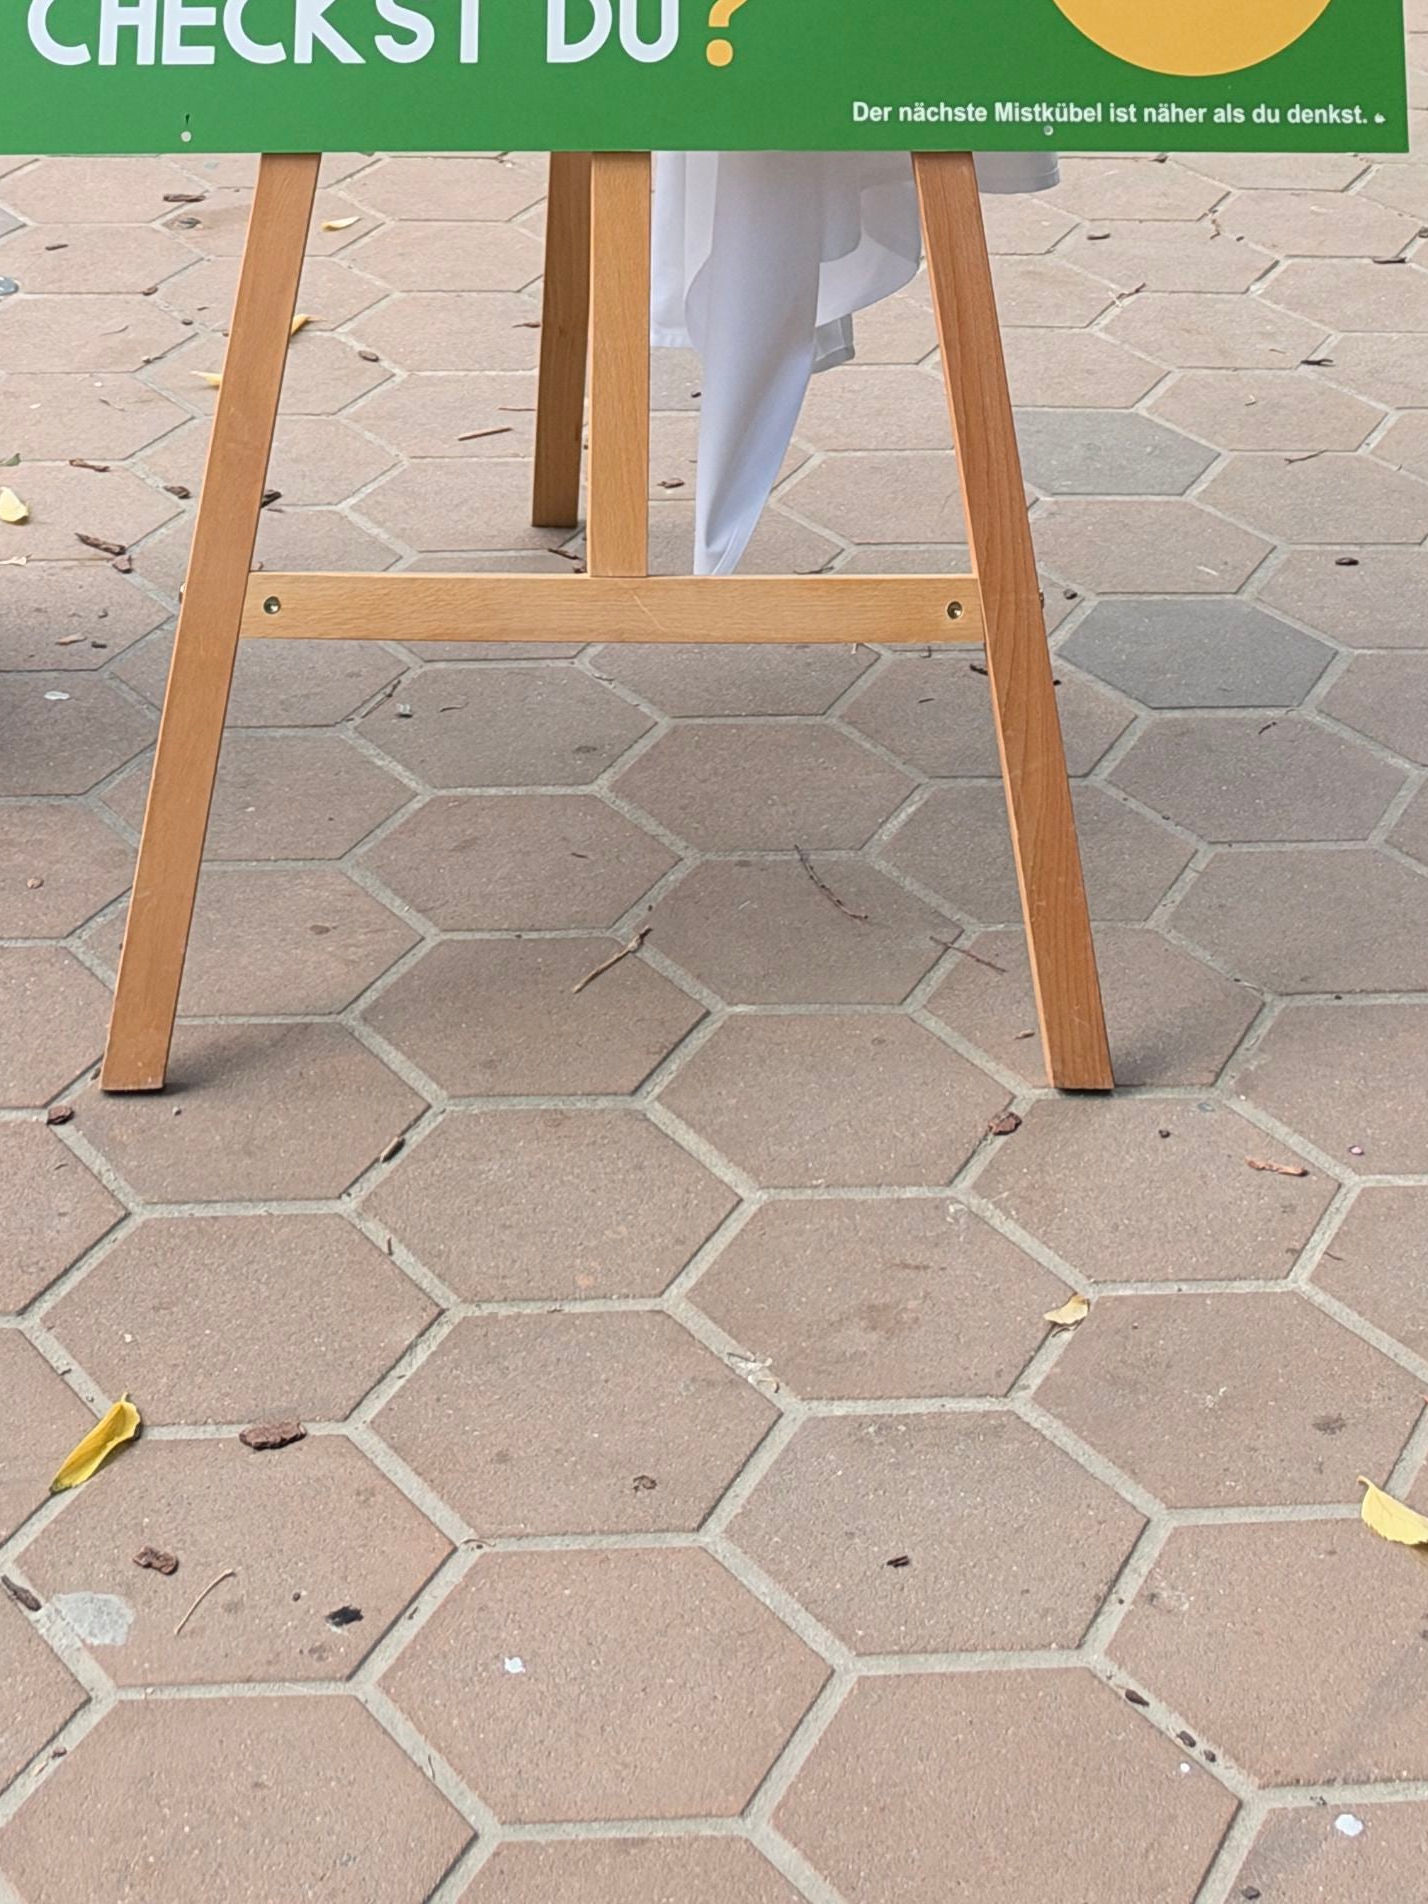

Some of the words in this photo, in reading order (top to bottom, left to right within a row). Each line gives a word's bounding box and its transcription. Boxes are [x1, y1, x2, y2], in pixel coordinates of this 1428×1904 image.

[852, 101, 892, 122] Der
[898, 102, 988, 123] nächste
[994, 101, 1102, 123] Mistkübel
[1109, 102, 1137, 123] ist
[1143, 102, 1207, 124] näher
[1213, 103, 1245, 124] als
[1252, 103, 1280, 124] du
[1287, 104, 1368, 124] denkst.
